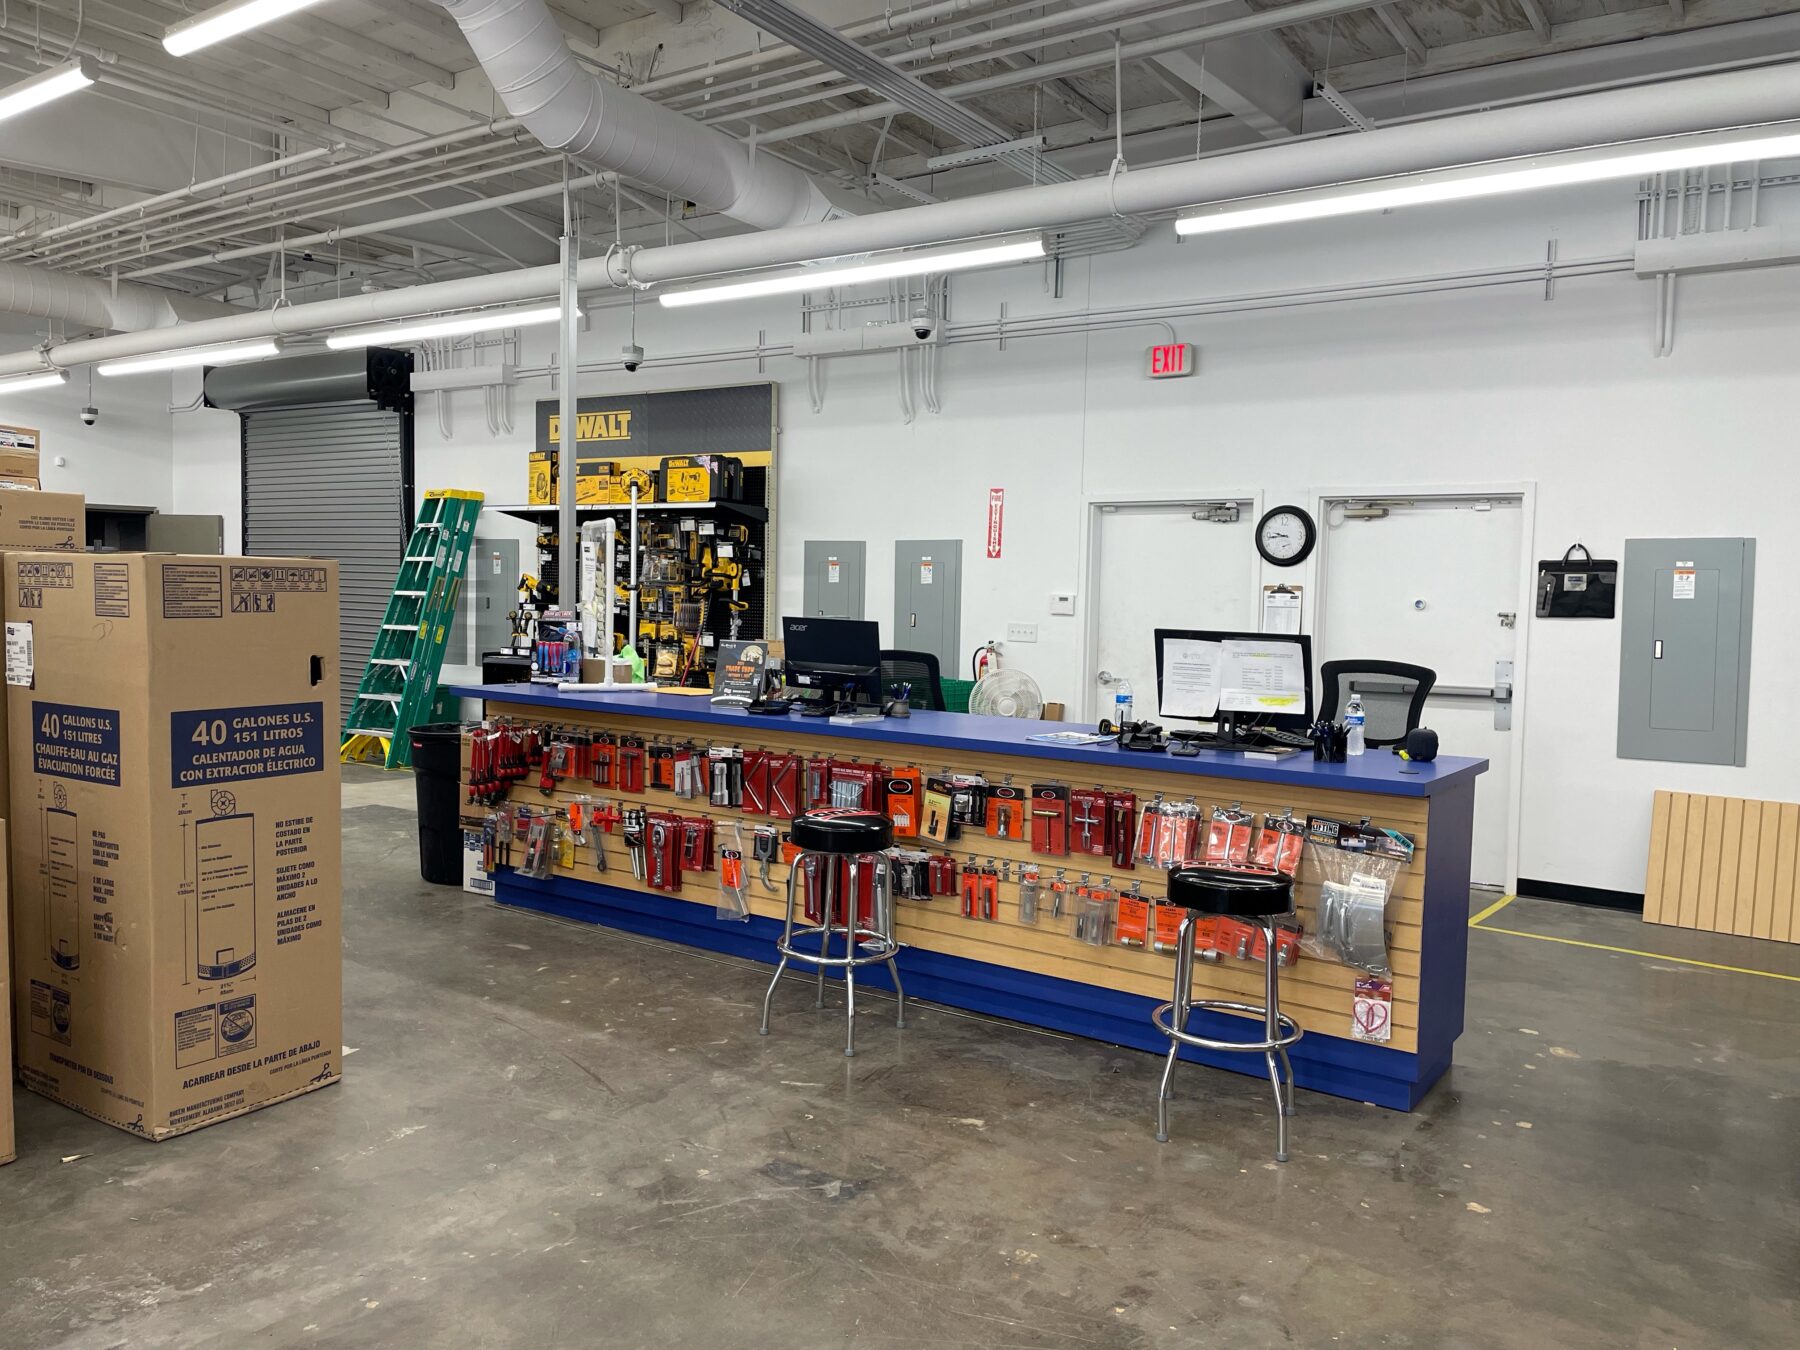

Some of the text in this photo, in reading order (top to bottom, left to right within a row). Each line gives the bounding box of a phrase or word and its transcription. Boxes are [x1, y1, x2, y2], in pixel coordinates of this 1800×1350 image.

[1152, 344, 1185, 373] EXIT
[549, 411, 631, 442] DWALT
[41, 712, 60, 739] 40
[62, 714, 112, 730] GALLONS U.S.
[233, 712, 314, 729] GALONES U.S.
[63, 730, 102, 744] 151 LITRES
[191, 719, 227, 746] 40
[233, 727, 303, 743] 151 LITROS
[35, 743, 118, 765] CHAUFFE-EAU AU GAZ
[192, 744, 305, 765] CALENTADOR DE AGUA
[38, 756, 115, 780] ÉVACUATION FORCÉE
[180, 757, 316, 781] CON EXTRACTOR ÉLECTRICO
[275, 821, 284, 829] NO
[285, 818, 304, 827] ESTIBE
[275, 828, 302, 838] COSTADO
[275, 837, 303, 848] LA PARTE
[275, 845, 308, 856] POSTERIOR
[276, 861, 315, 874] SUJETE COMO
[276, 872, 301, 883] MÁXIMO
[276, 881, 305, 892] UNIDADES
[276, 891, 296, 901] ANCHO
[277, 906, 307, 918] ALMACENE
[277, 918, 293, 927] PILAS
[277, 920, 322, 936] UNIDADES COMO
[277, 934, 301, 945] MÁXIMO
[182, 1040, 321, 1089] ACARREAR DESDE LA PARTE DE ABAJO
[223, 1089, 245, 1101] COMPANY
